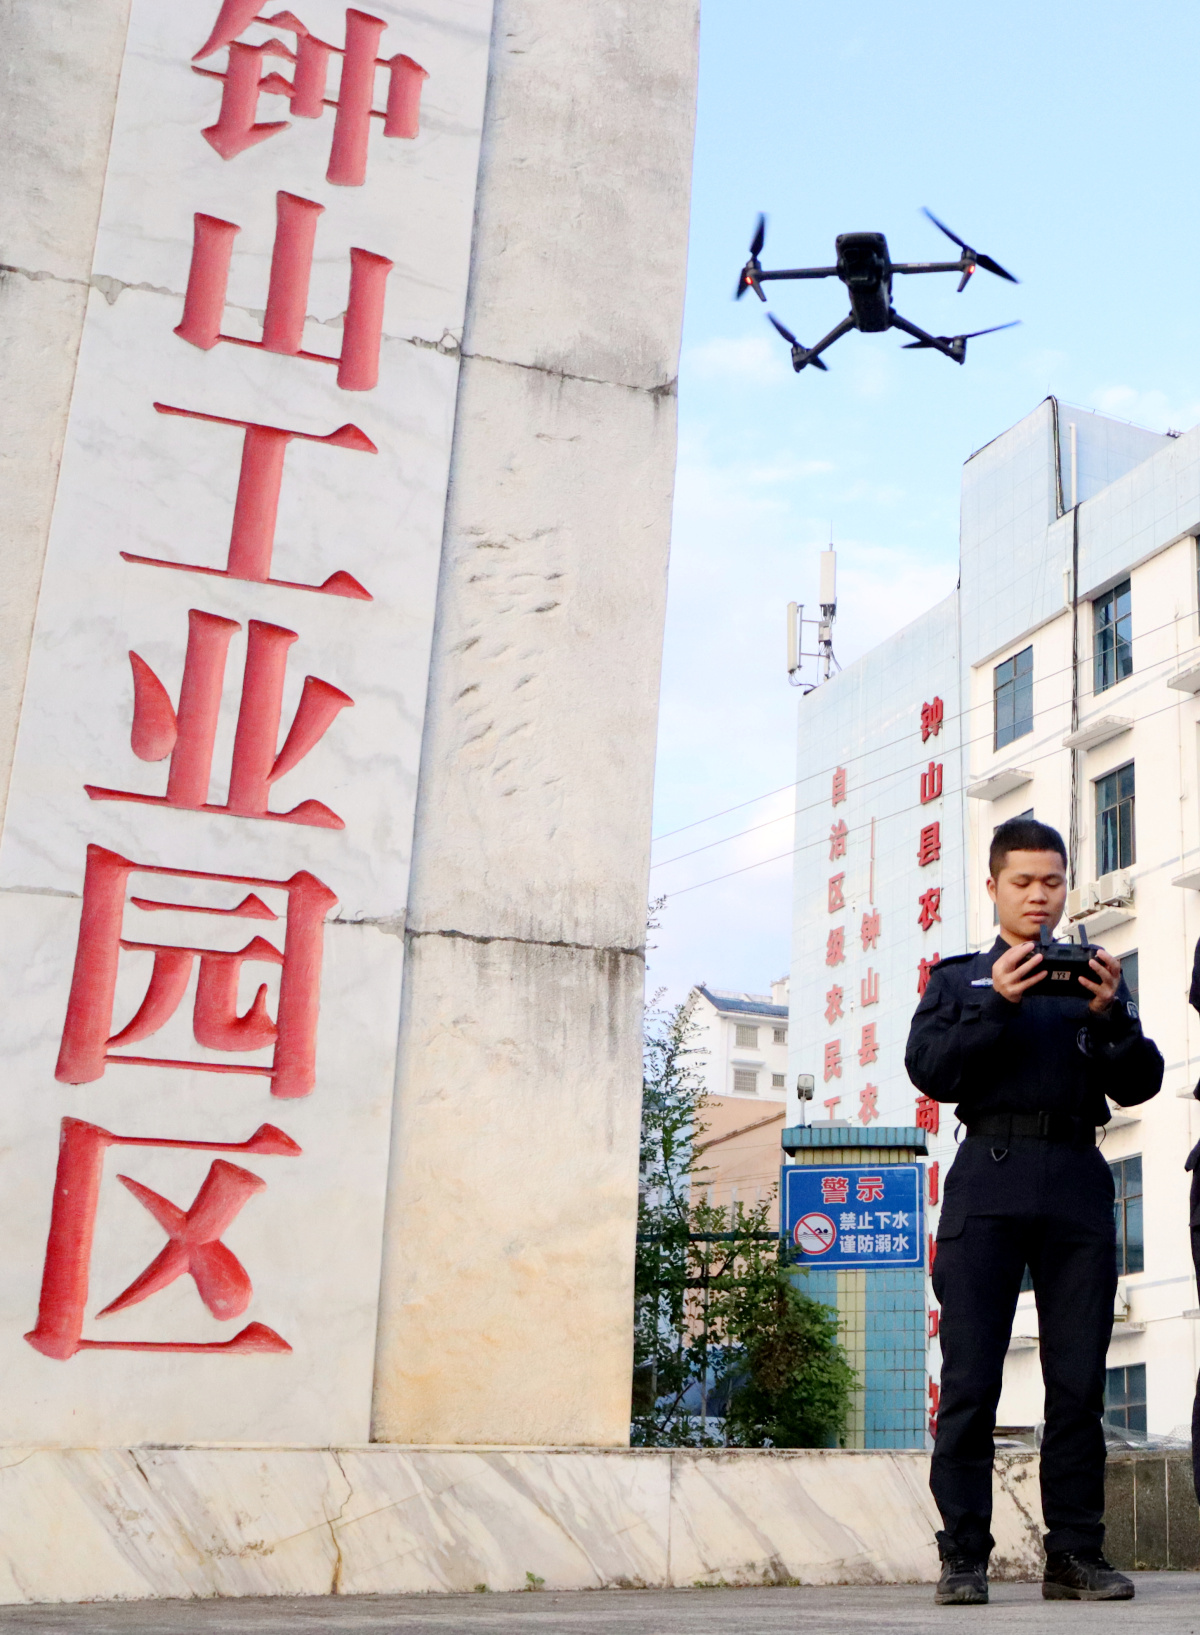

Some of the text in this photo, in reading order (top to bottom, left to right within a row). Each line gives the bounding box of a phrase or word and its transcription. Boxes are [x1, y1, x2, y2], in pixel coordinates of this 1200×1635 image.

[23, 0, 430, 1360] 钟山工业园区
[821, 1176, 885, 1204] 警示
[839, 1211, 910, 1231] 禁止下水
[839, 1234, 910, 1254] 谨防溺水
